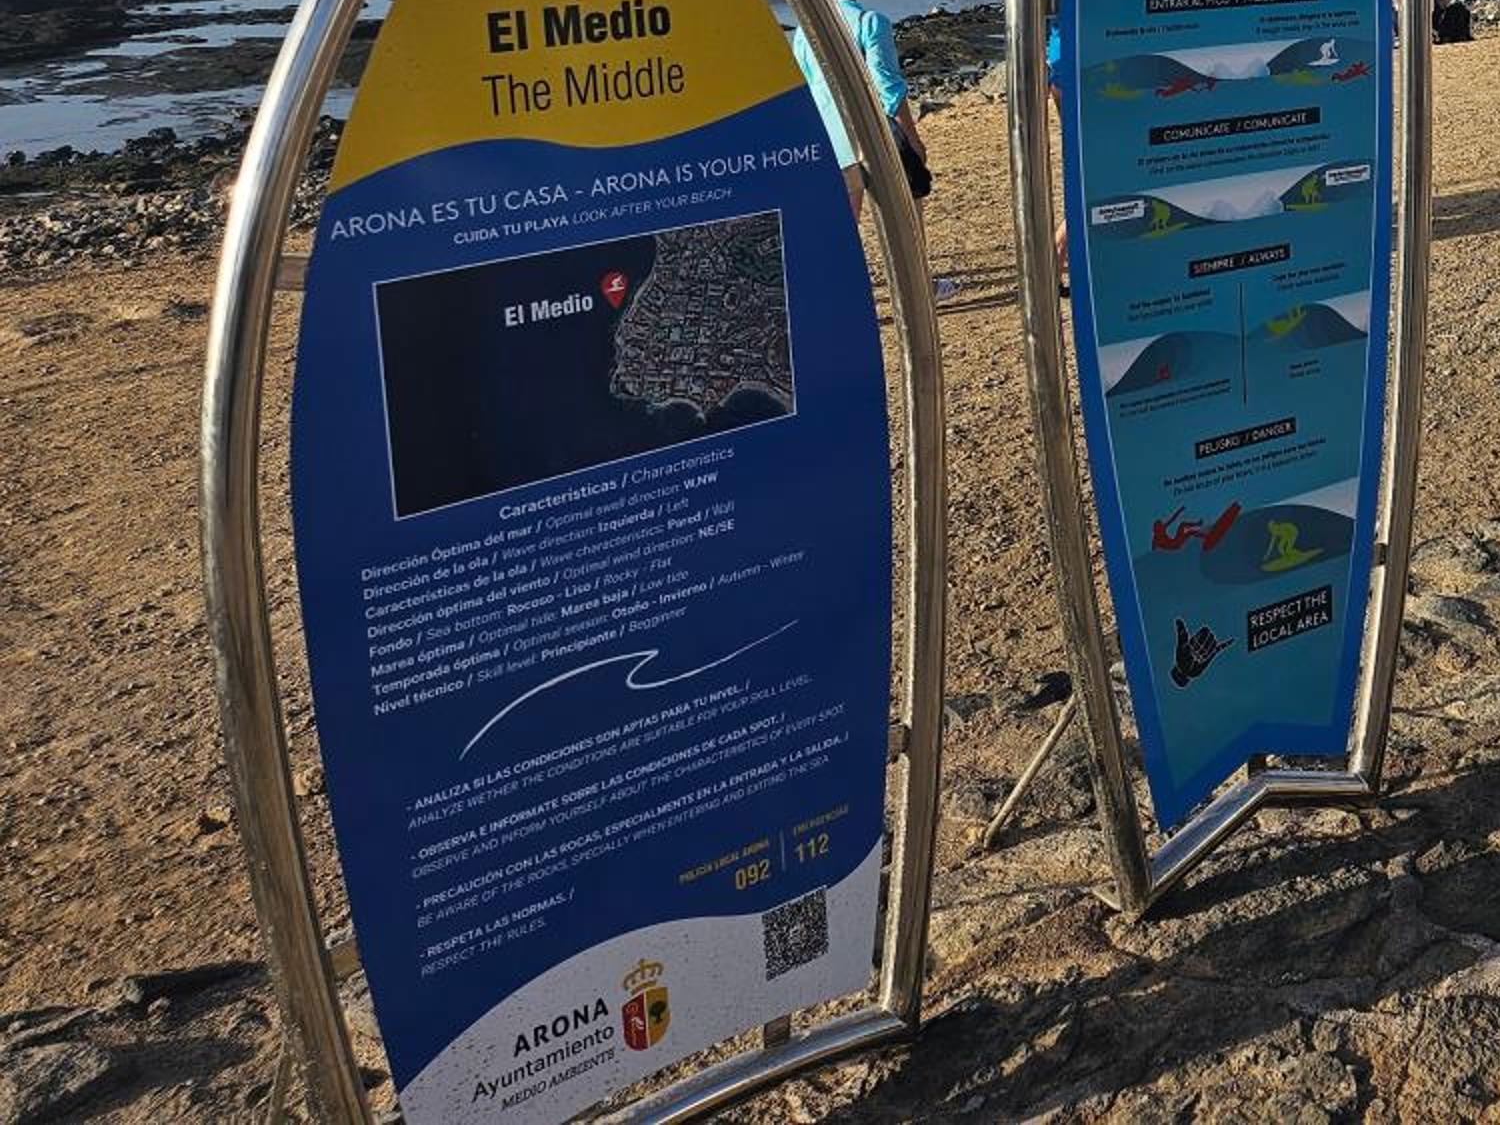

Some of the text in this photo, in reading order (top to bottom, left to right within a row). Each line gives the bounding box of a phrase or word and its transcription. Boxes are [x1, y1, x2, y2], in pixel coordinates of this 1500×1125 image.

[486, 9, 529, 53] El
[481, 54, 685, 117] The Middle
[329, 204, 425, 240] ARONA
[431, 199, 459, 224] ES
[464, 193, 497, 218] TU
[503, 182, 568, 212] CASA
[589, 166, 670, 198] ARONA
[675, 162, 693, 183] IS
[697, 153, 756, 180] YOUR
[761, 142, 821, 169] HOME
[452, 225, 499, 245] CUIDA
[502, 222, 521, 237] TU
[524, 214, 569, 233] PLAYA
[571, 207, 607, 225] LOOK
[609, 200, 651, 218] AFTER
[654, 194, 687, 210] YOUR
[503, 290, 593, 327] El Medio
[360, 551, 429, 583] Dirección
[483, 530, 504, 548] del
[507, 524, 533, 541] mar
[362, 570, 429, 601] Dirección
[432, 564, 450, 581] de
[452, 560, 465, 575] la
[468, 553, 489, 570] ola
[597, 506, 655, 535] Izquierda
[473, 572, 490, 589] de
[492, 567, 505, 583] la
[507, 561, 527, 578] ola
[485, 586, 507, 604] del
[509, 573, 550, 597] viento
[601, 586, 629, 607] baja
[1249, 589, 1327, 629] RESPECT THE
[368, 634, 413, 660] Fondo
[1252, 607, 1328, 648] LOCAL AREA
[373, 694, 410, 717] Nivel
[414, 780, 471, 812] ANALIZA
[486, 765, 511, 785] LAS
[513, 736, 593, 776] CONDICIONES
[660, 700, 690, 721] PARA
[693, 694, 707, 709] TU
[600, 772, 624, 791] LAS
[504, 856, 532, 877] CON
[535, 846, 558, 865] LAS
[713, 779, 727, 794] LA
[788, 748, 802, 763] LA
[735, 859, 770, 890] 092
[795, 833, 829, 863] 112
[484, 914, 509, 934] LAS
[513, 998, 609, 1057] ARONA
[472, 1026, 614, 1102] Ayuntamiento
[501, 1080, 546, 1110] MEDIO
